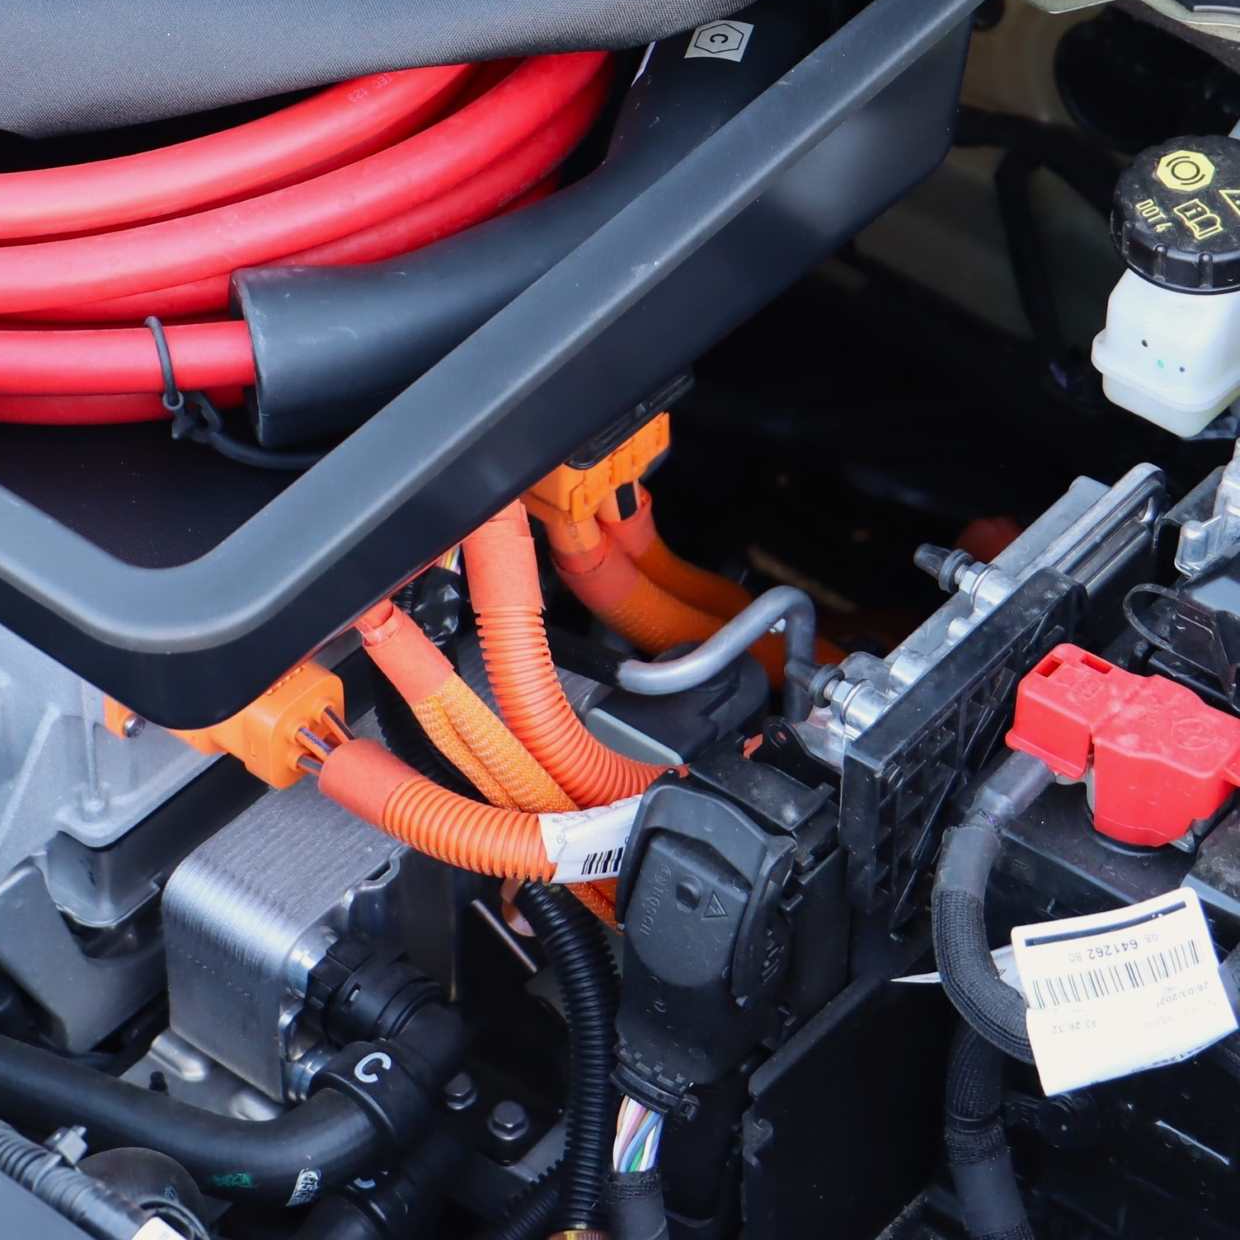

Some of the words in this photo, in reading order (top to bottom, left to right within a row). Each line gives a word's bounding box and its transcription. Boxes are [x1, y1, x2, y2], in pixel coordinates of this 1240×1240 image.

[1135, 198, 1166, 223] DOT
[1154, 221, 1173, 233] 4
[1087, 938, 1139, 961] 641262
[353, 1051, 392, 1084] C
